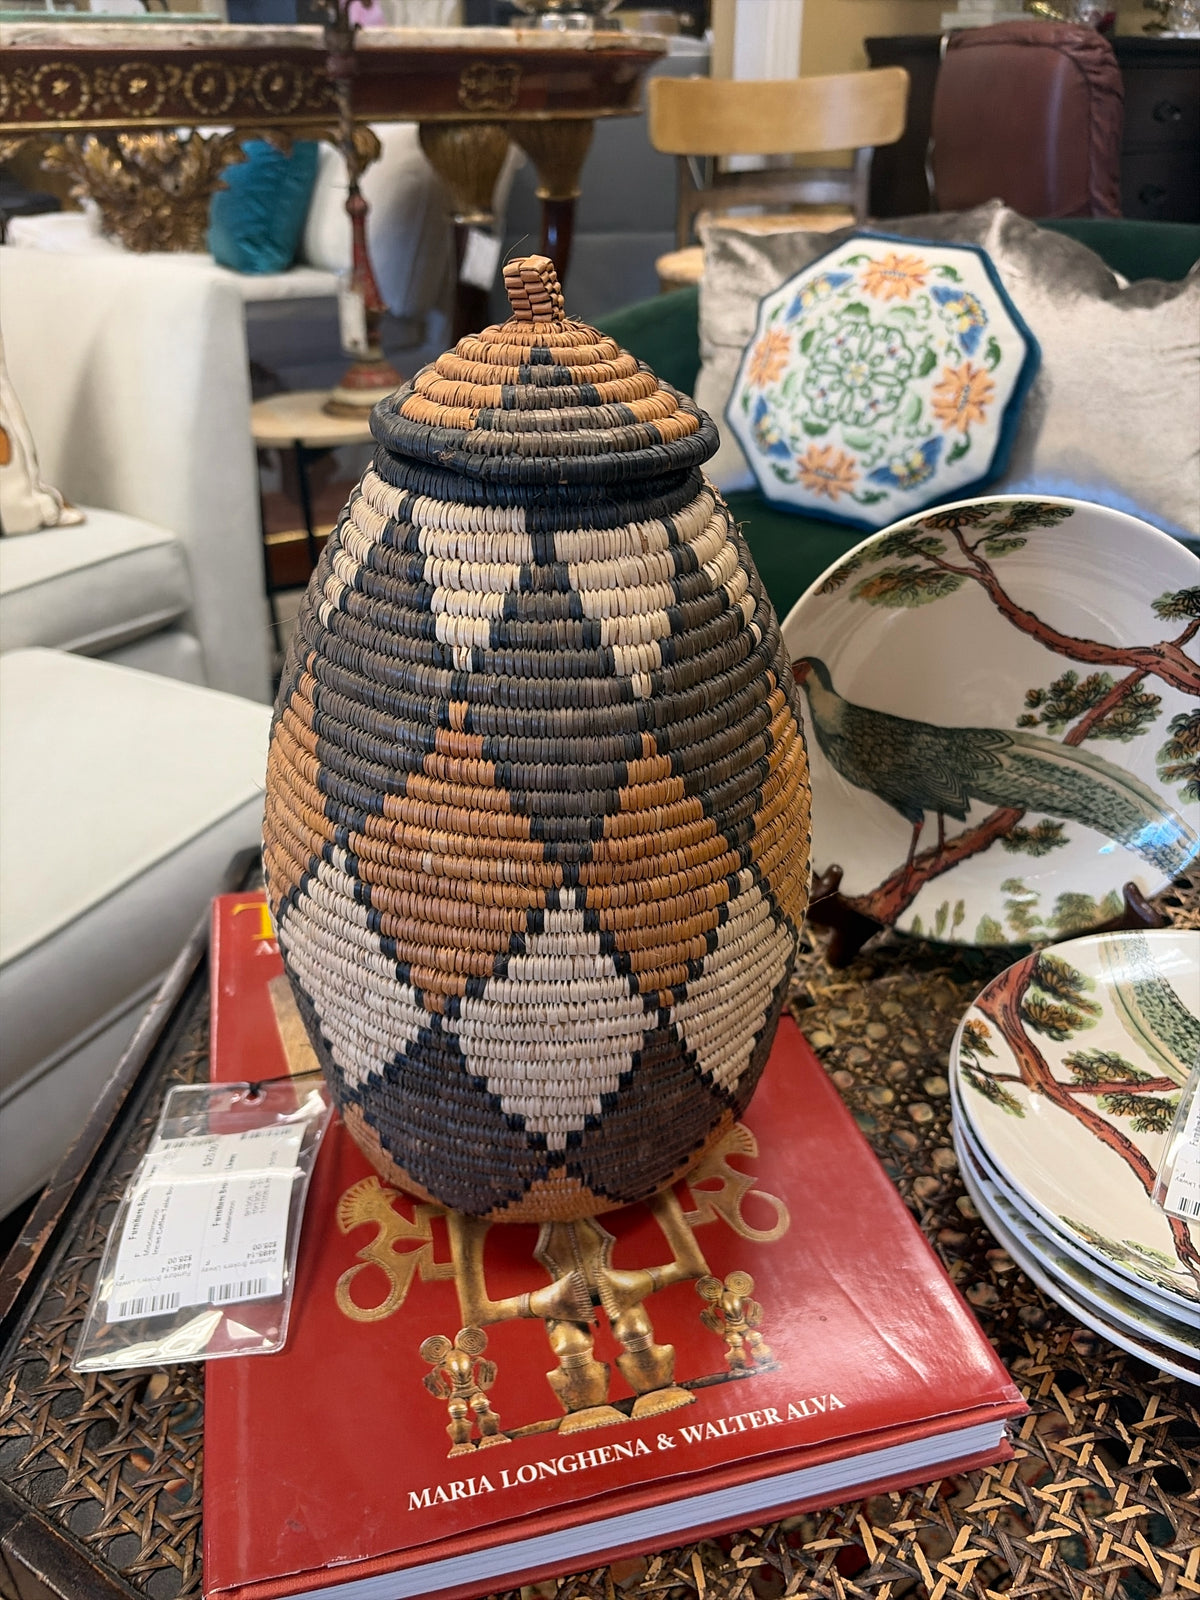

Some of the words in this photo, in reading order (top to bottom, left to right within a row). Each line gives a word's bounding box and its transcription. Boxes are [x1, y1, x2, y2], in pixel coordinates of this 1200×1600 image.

[128, 1208, 143, 1240] Furniture
[212, 1194, 226, 1226] Furniture
[407, 1475, 495, 1511] MARIA
[499, 1440, 652, 1488] LONGHENA
[656, 1432, 677, 1451] &
[679, 1409, 783, 1444] WALTER
[786, 1392, 846, 1420] ALVA
